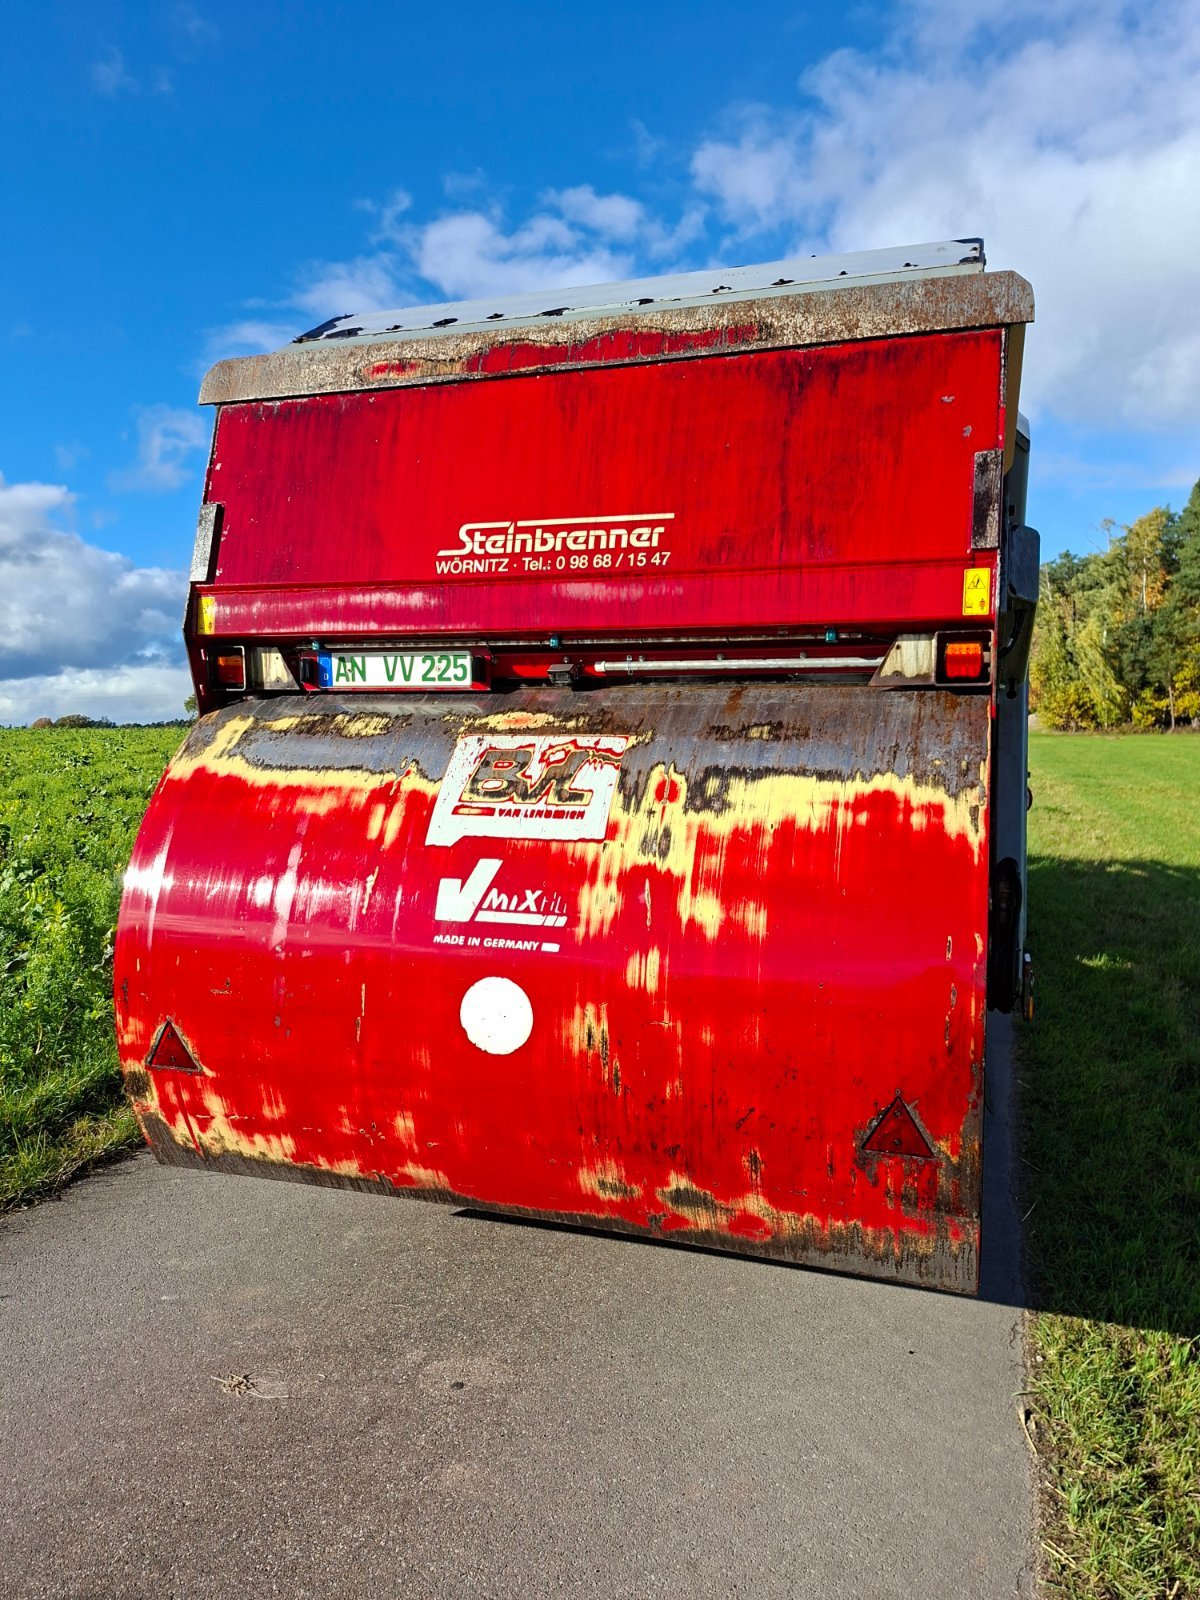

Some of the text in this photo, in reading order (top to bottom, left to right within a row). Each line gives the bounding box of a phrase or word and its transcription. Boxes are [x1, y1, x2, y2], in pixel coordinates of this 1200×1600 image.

[437, 513, 675, 556] Steinbrenner
[435, 557, 509, 574] WÖRNITZ
[556, 556, 566, 570] 0
[569, 555, 589, 569] 98
[593, 554, 612, 568] 68
[628, 552, 647, 567] 15
[651, 552, 671, 566] 47
[335, 655, 468, 682] AN VV 225
[433, 935, 540, 951] MADE IN GERMANY
